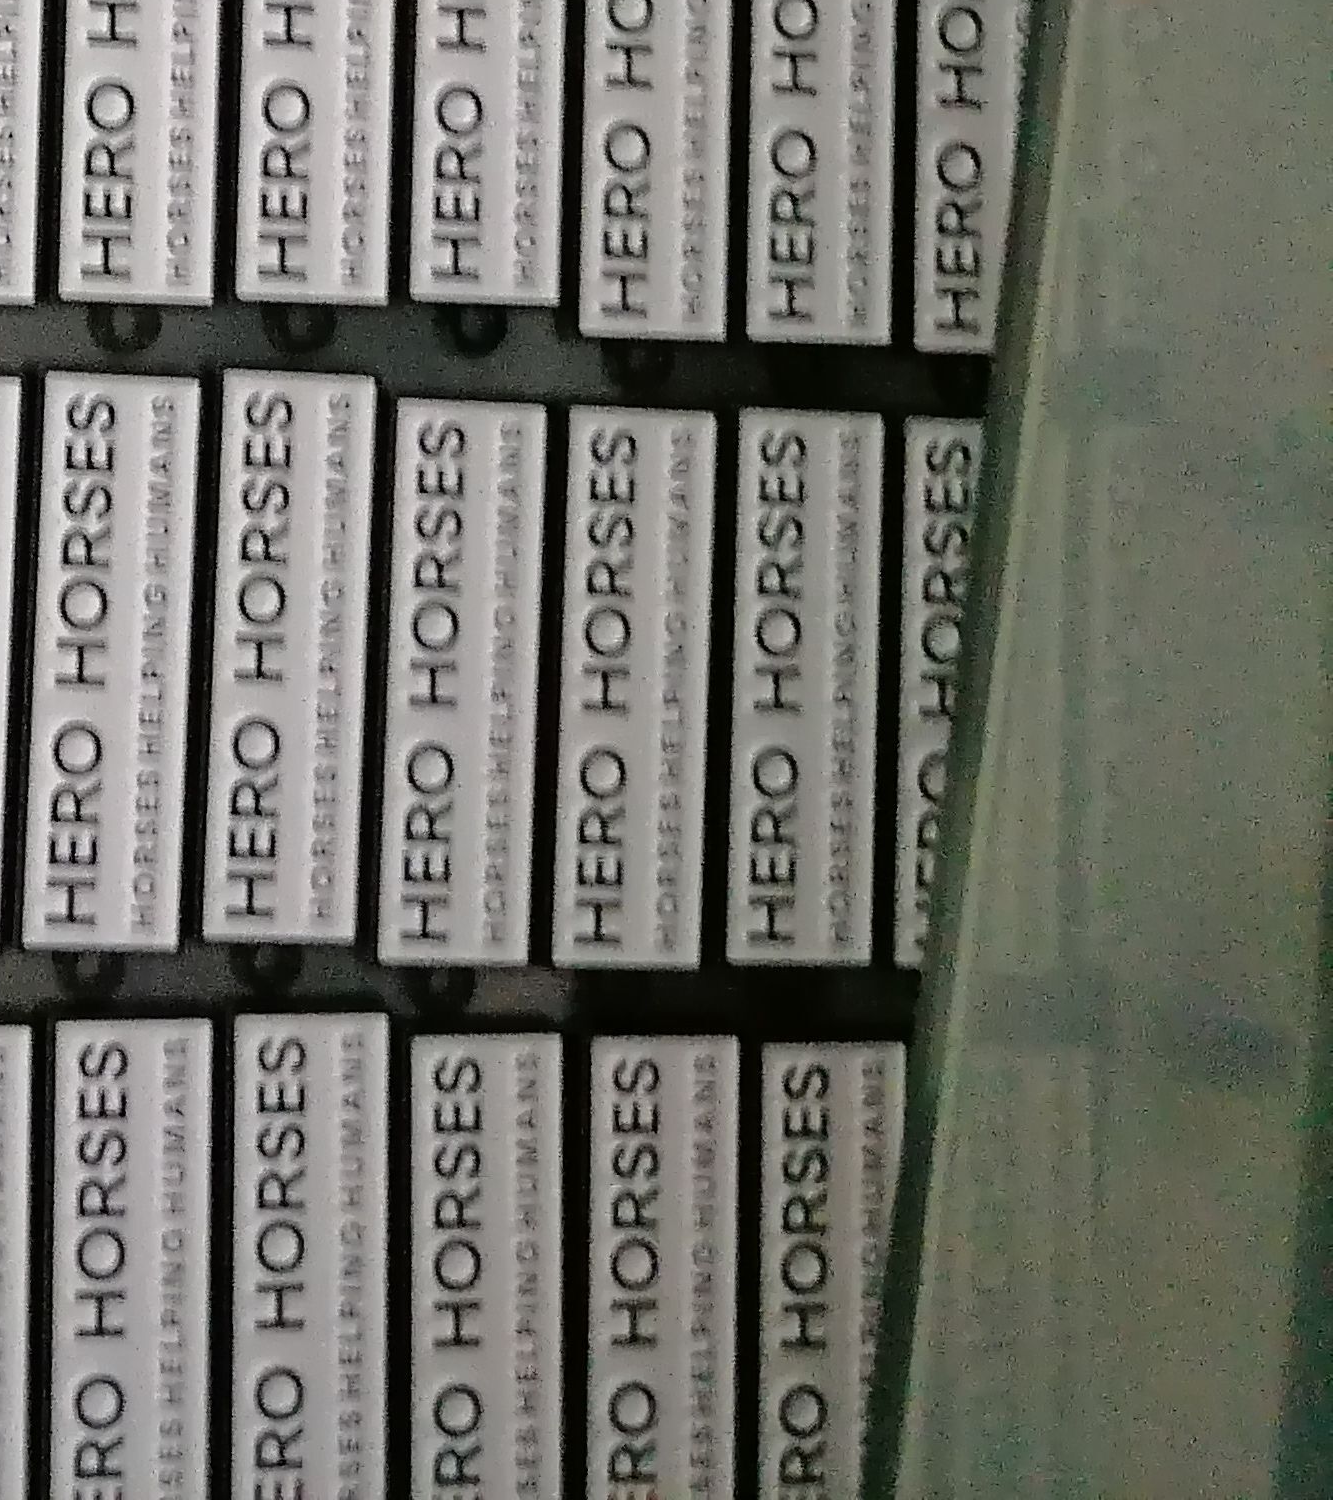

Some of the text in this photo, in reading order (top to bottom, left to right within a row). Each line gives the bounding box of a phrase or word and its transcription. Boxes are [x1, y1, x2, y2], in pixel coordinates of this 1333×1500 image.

[80, 80, 138, 280] HERO
[431, 84, 486, 282] HERO
[767, 128, 819, 321] HERO
[932, 139, 985, 333] HERO
[44, 395, 119, 925] HERO HORSES
[224, 392, 296, 918] HERO HORSES
[573, 428, 640, 945] HERO HORSES
[747, 431, 808, 941] HERO HORSES
[75, 1042, 130, 1340] HORSES
[610, 1059, 662, 1349] HORSES
